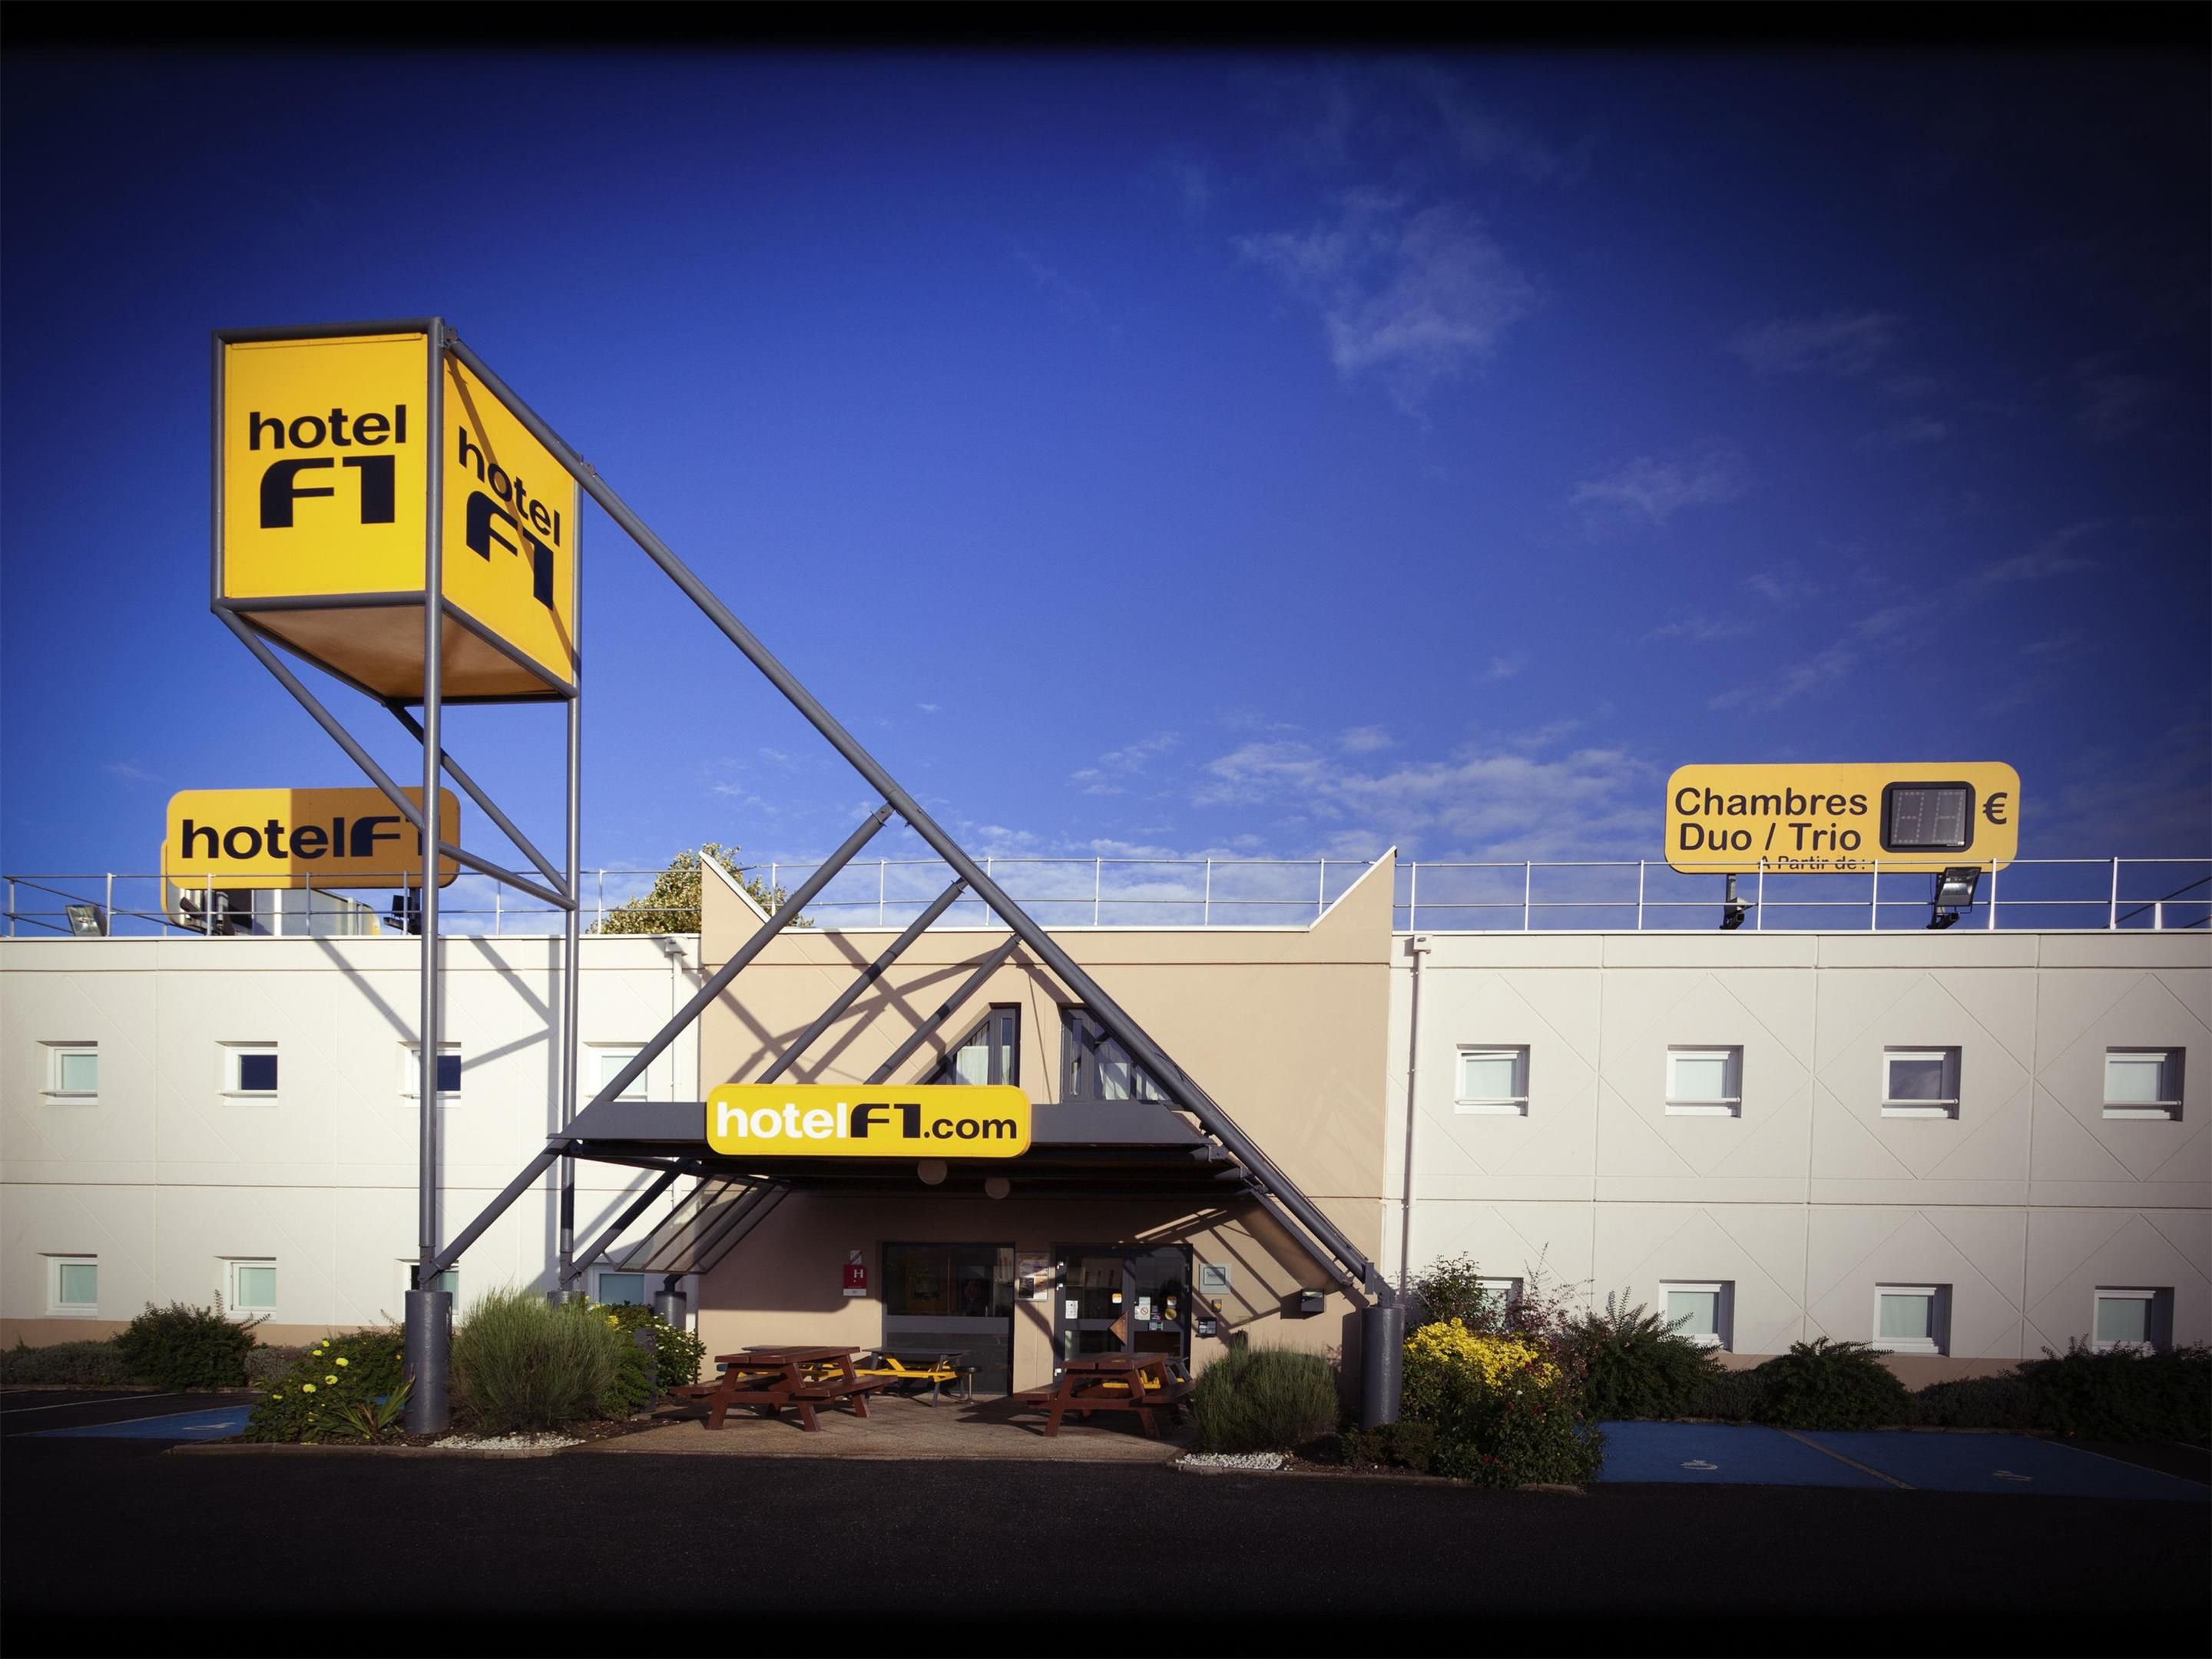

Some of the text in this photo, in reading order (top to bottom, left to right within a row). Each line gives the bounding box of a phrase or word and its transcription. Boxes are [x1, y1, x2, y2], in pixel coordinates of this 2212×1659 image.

[250, 405, 406, 451] hotel
[260, 455, 395, 528] F1
[459, 426, 560, 547] hotel
[467, 491, 554, 611] F1
[1674, 787, 1868, 816] Chambres
[1983, 793, 2008, 824] €
[182, 816, 441, 859] hotelF
[1680, 823, 1861, 851] Duo / Trio
[1778, 856, 1829, 869] Partir
[717, 1102, 1017, 1139] hotelF1.com
